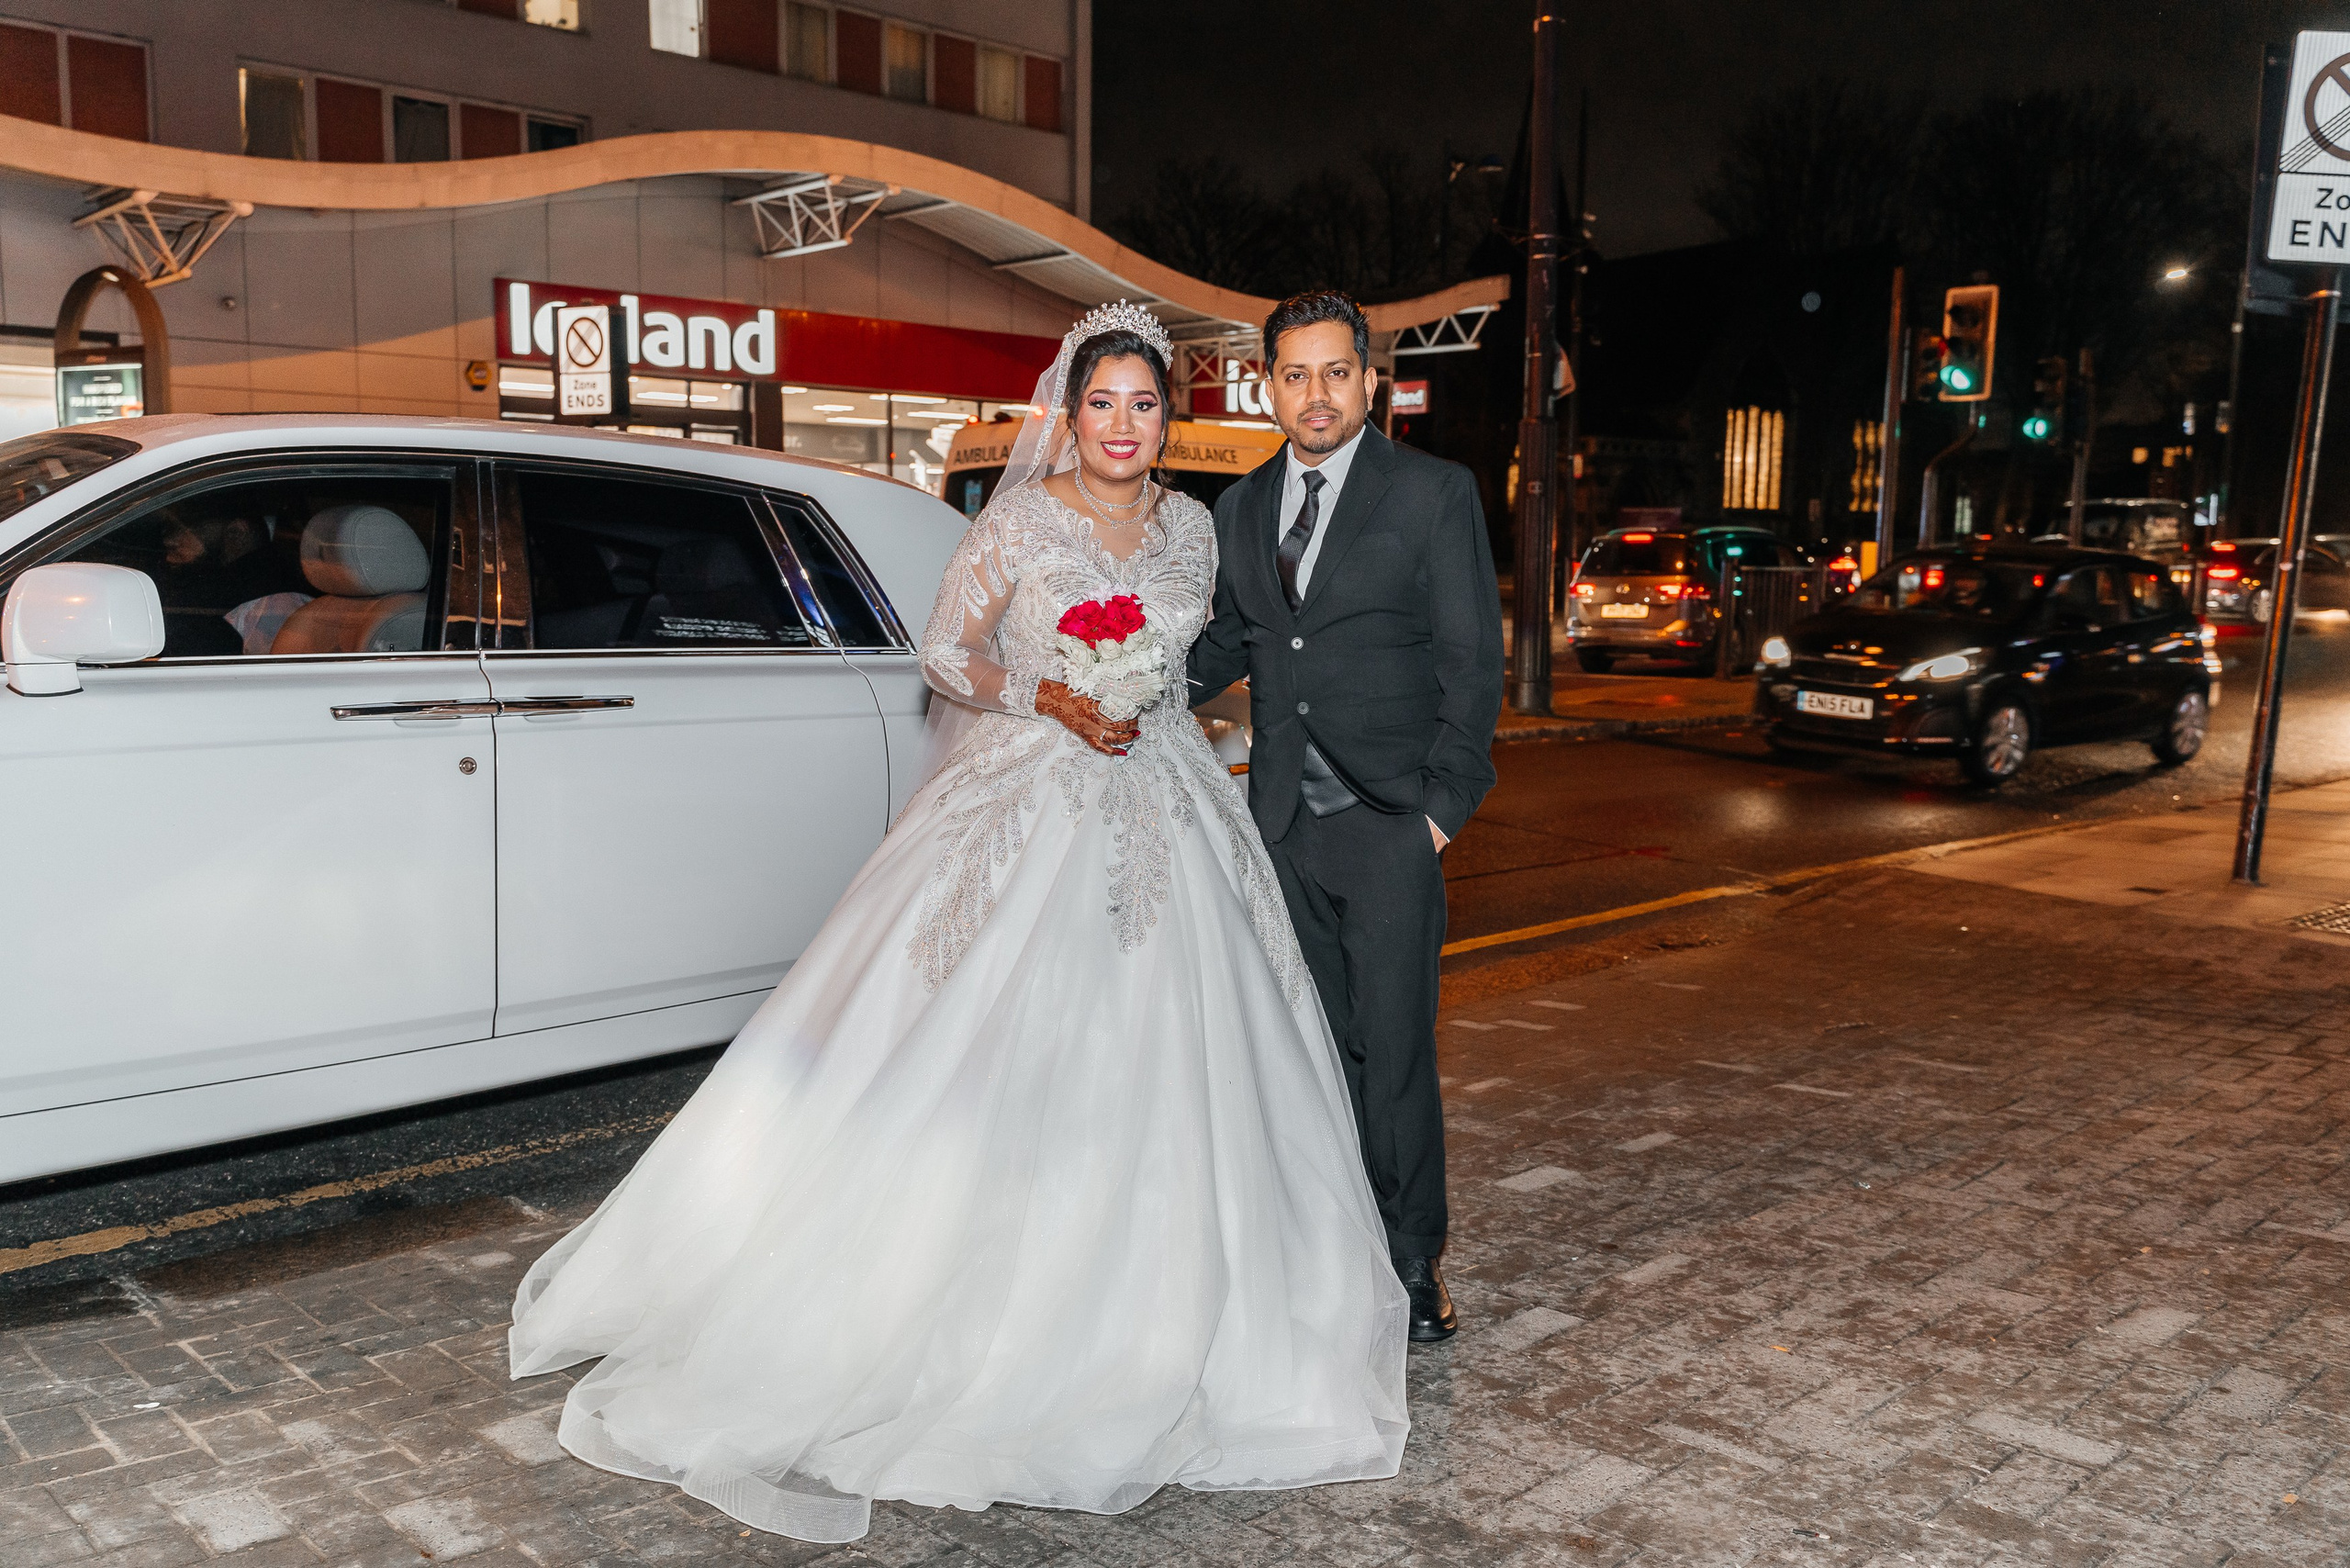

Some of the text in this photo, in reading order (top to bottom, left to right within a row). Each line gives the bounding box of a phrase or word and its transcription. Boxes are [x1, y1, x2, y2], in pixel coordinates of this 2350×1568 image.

[2314, 187, 2350, 210] Zo
[2288, 219, 2347, 249] EN
[509, 283, 776, 375] Icland
[574, 379, 597, 390] Zone
[567, 394, 605, 408] ENDS
[1165, 444, 1238, 465] MBULANCE
